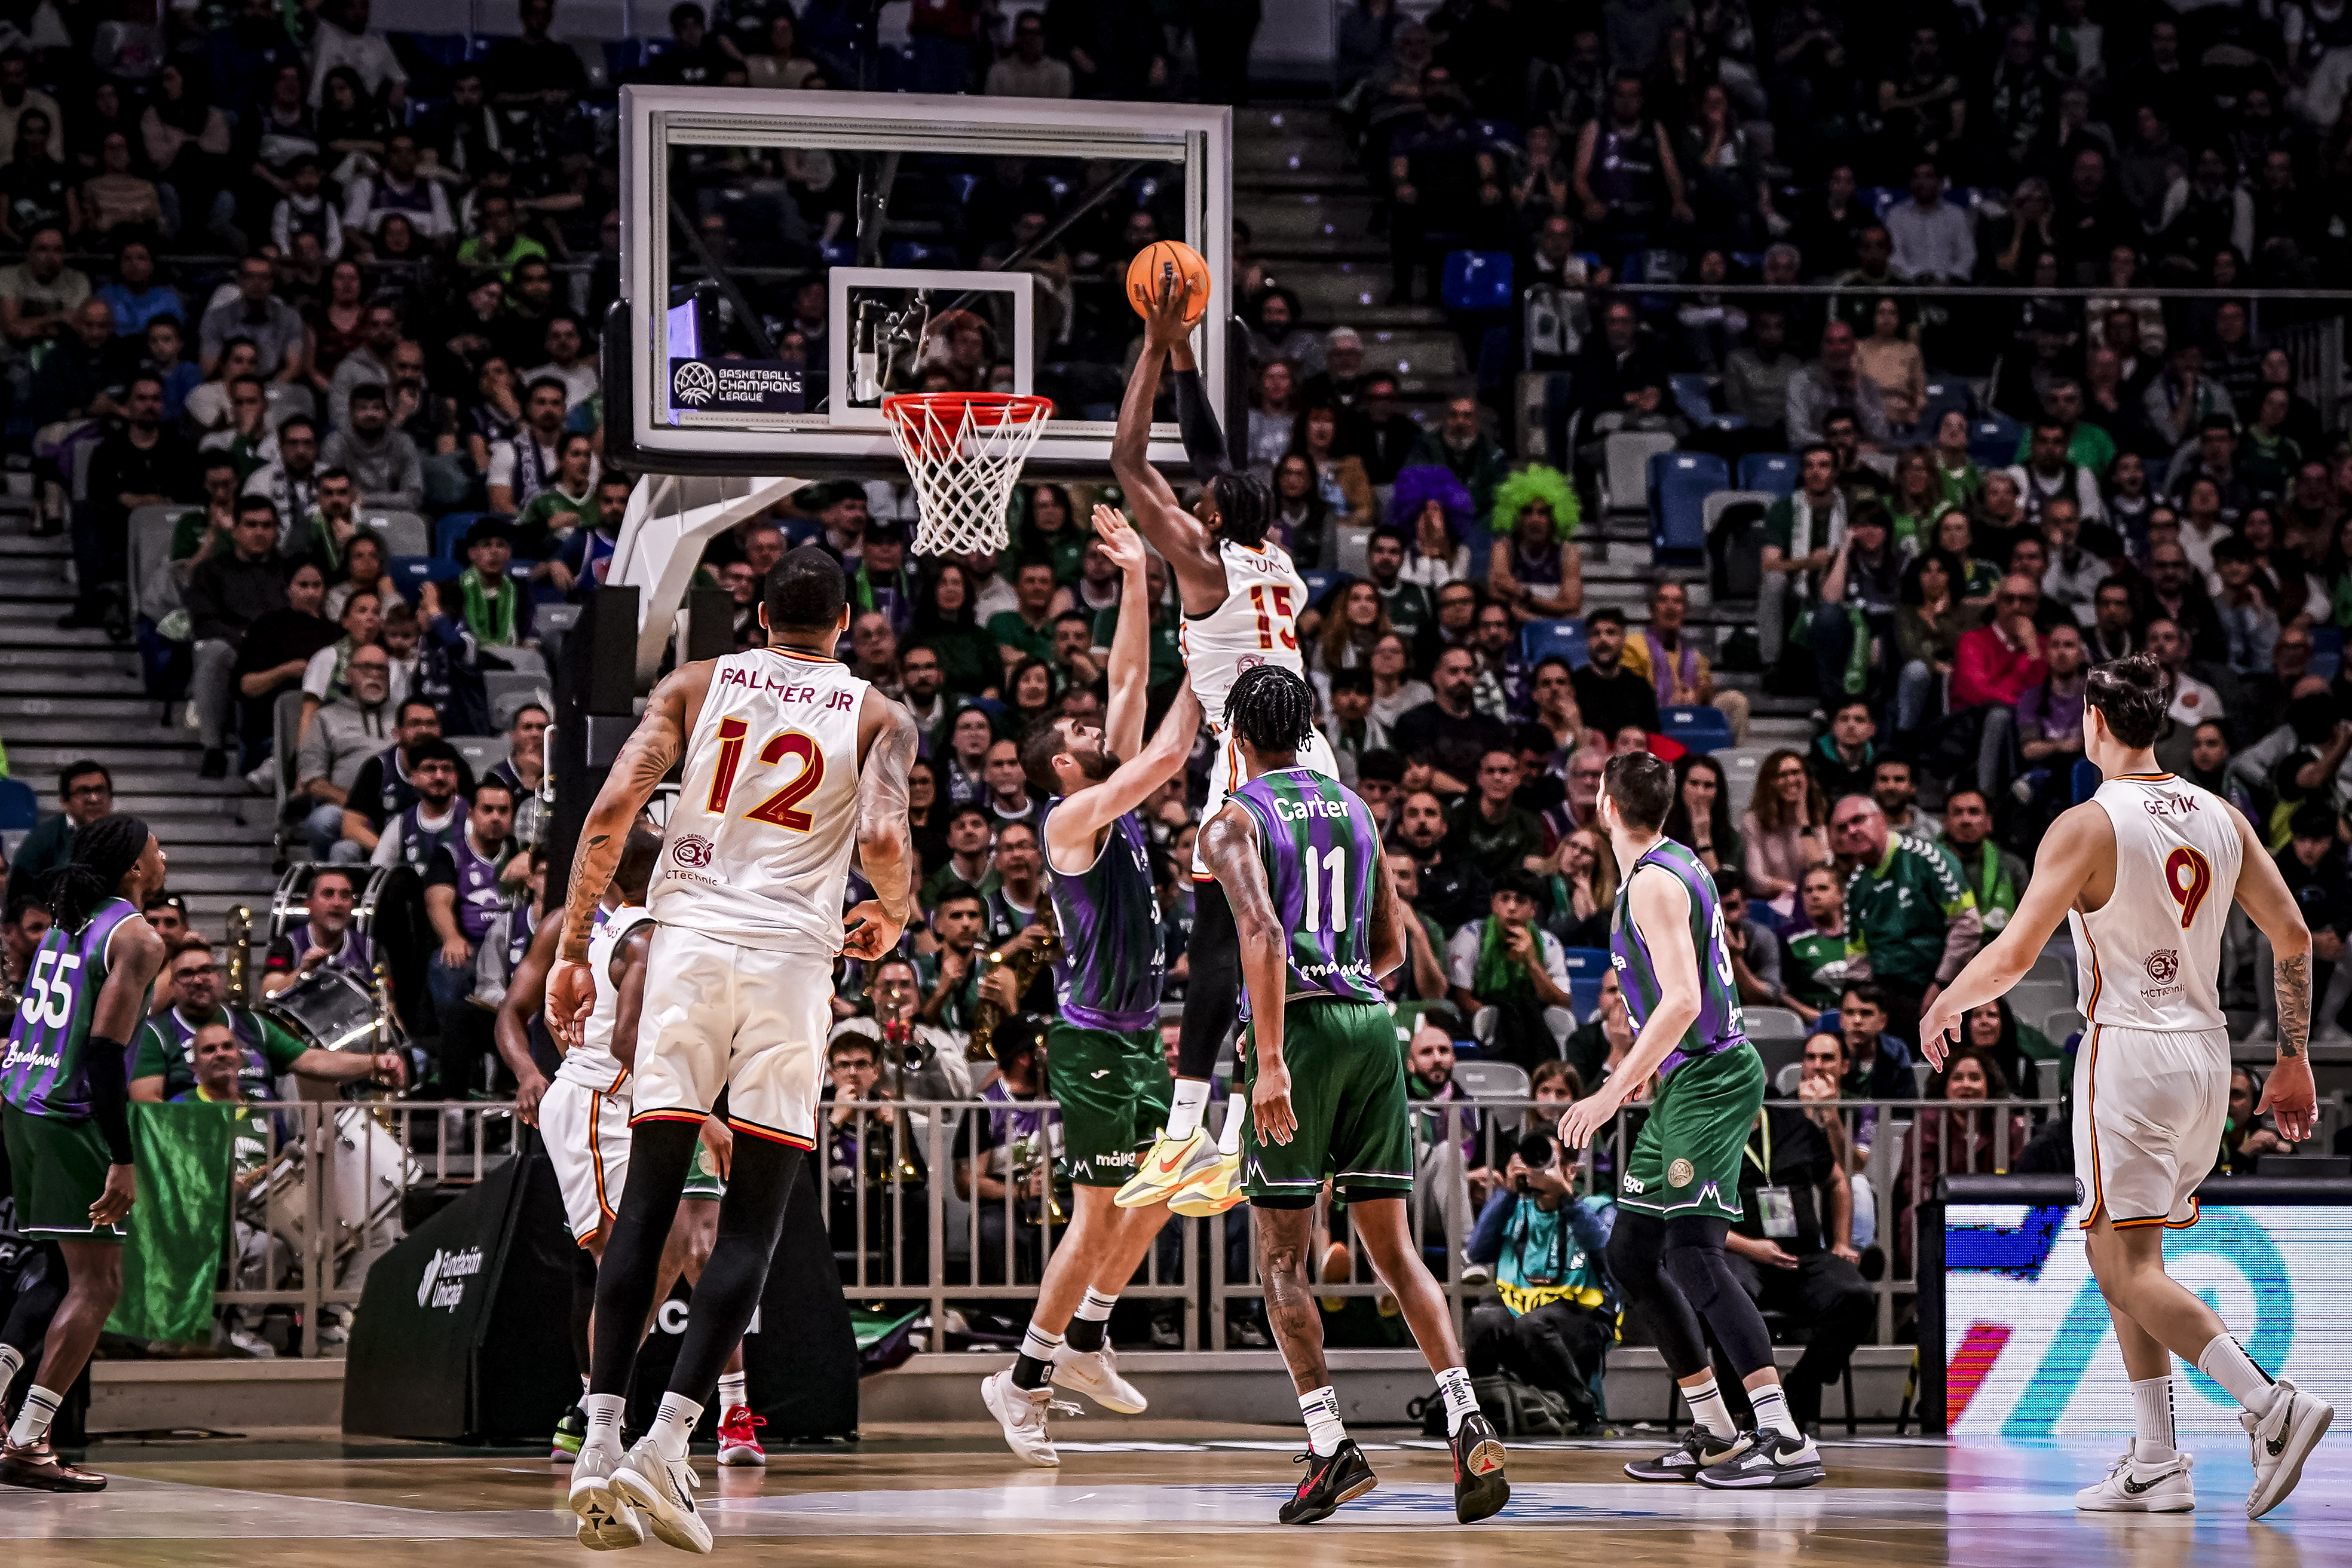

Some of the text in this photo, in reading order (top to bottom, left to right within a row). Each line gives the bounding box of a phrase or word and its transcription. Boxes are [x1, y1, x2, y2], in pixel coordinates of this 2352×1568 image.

[719, 369, 792, 381] BASKETBALL
[719, 379, 802, 394] CHAMPIONS
[719, 391, 763, 403] LEAGUE
[1250, 584, 1296, 651] 15
[721, 667, 854, 712] PALMER JR
[706, 716, 827, 834] 12
[1273, 794, 1349, 822] Carter
[1305, 844, 1346, 933] 11
[2164, 846, 2212, 930] 9
[22, 950, 81, 1029] 55
[439, 1245, 485, 1278] Fundación
[431, 1277, 465, 1313] Unicaja
[1448, 1378, 1470, 1406] UNICAJ
[1324, 1397, 1343, 1422] UNICA
